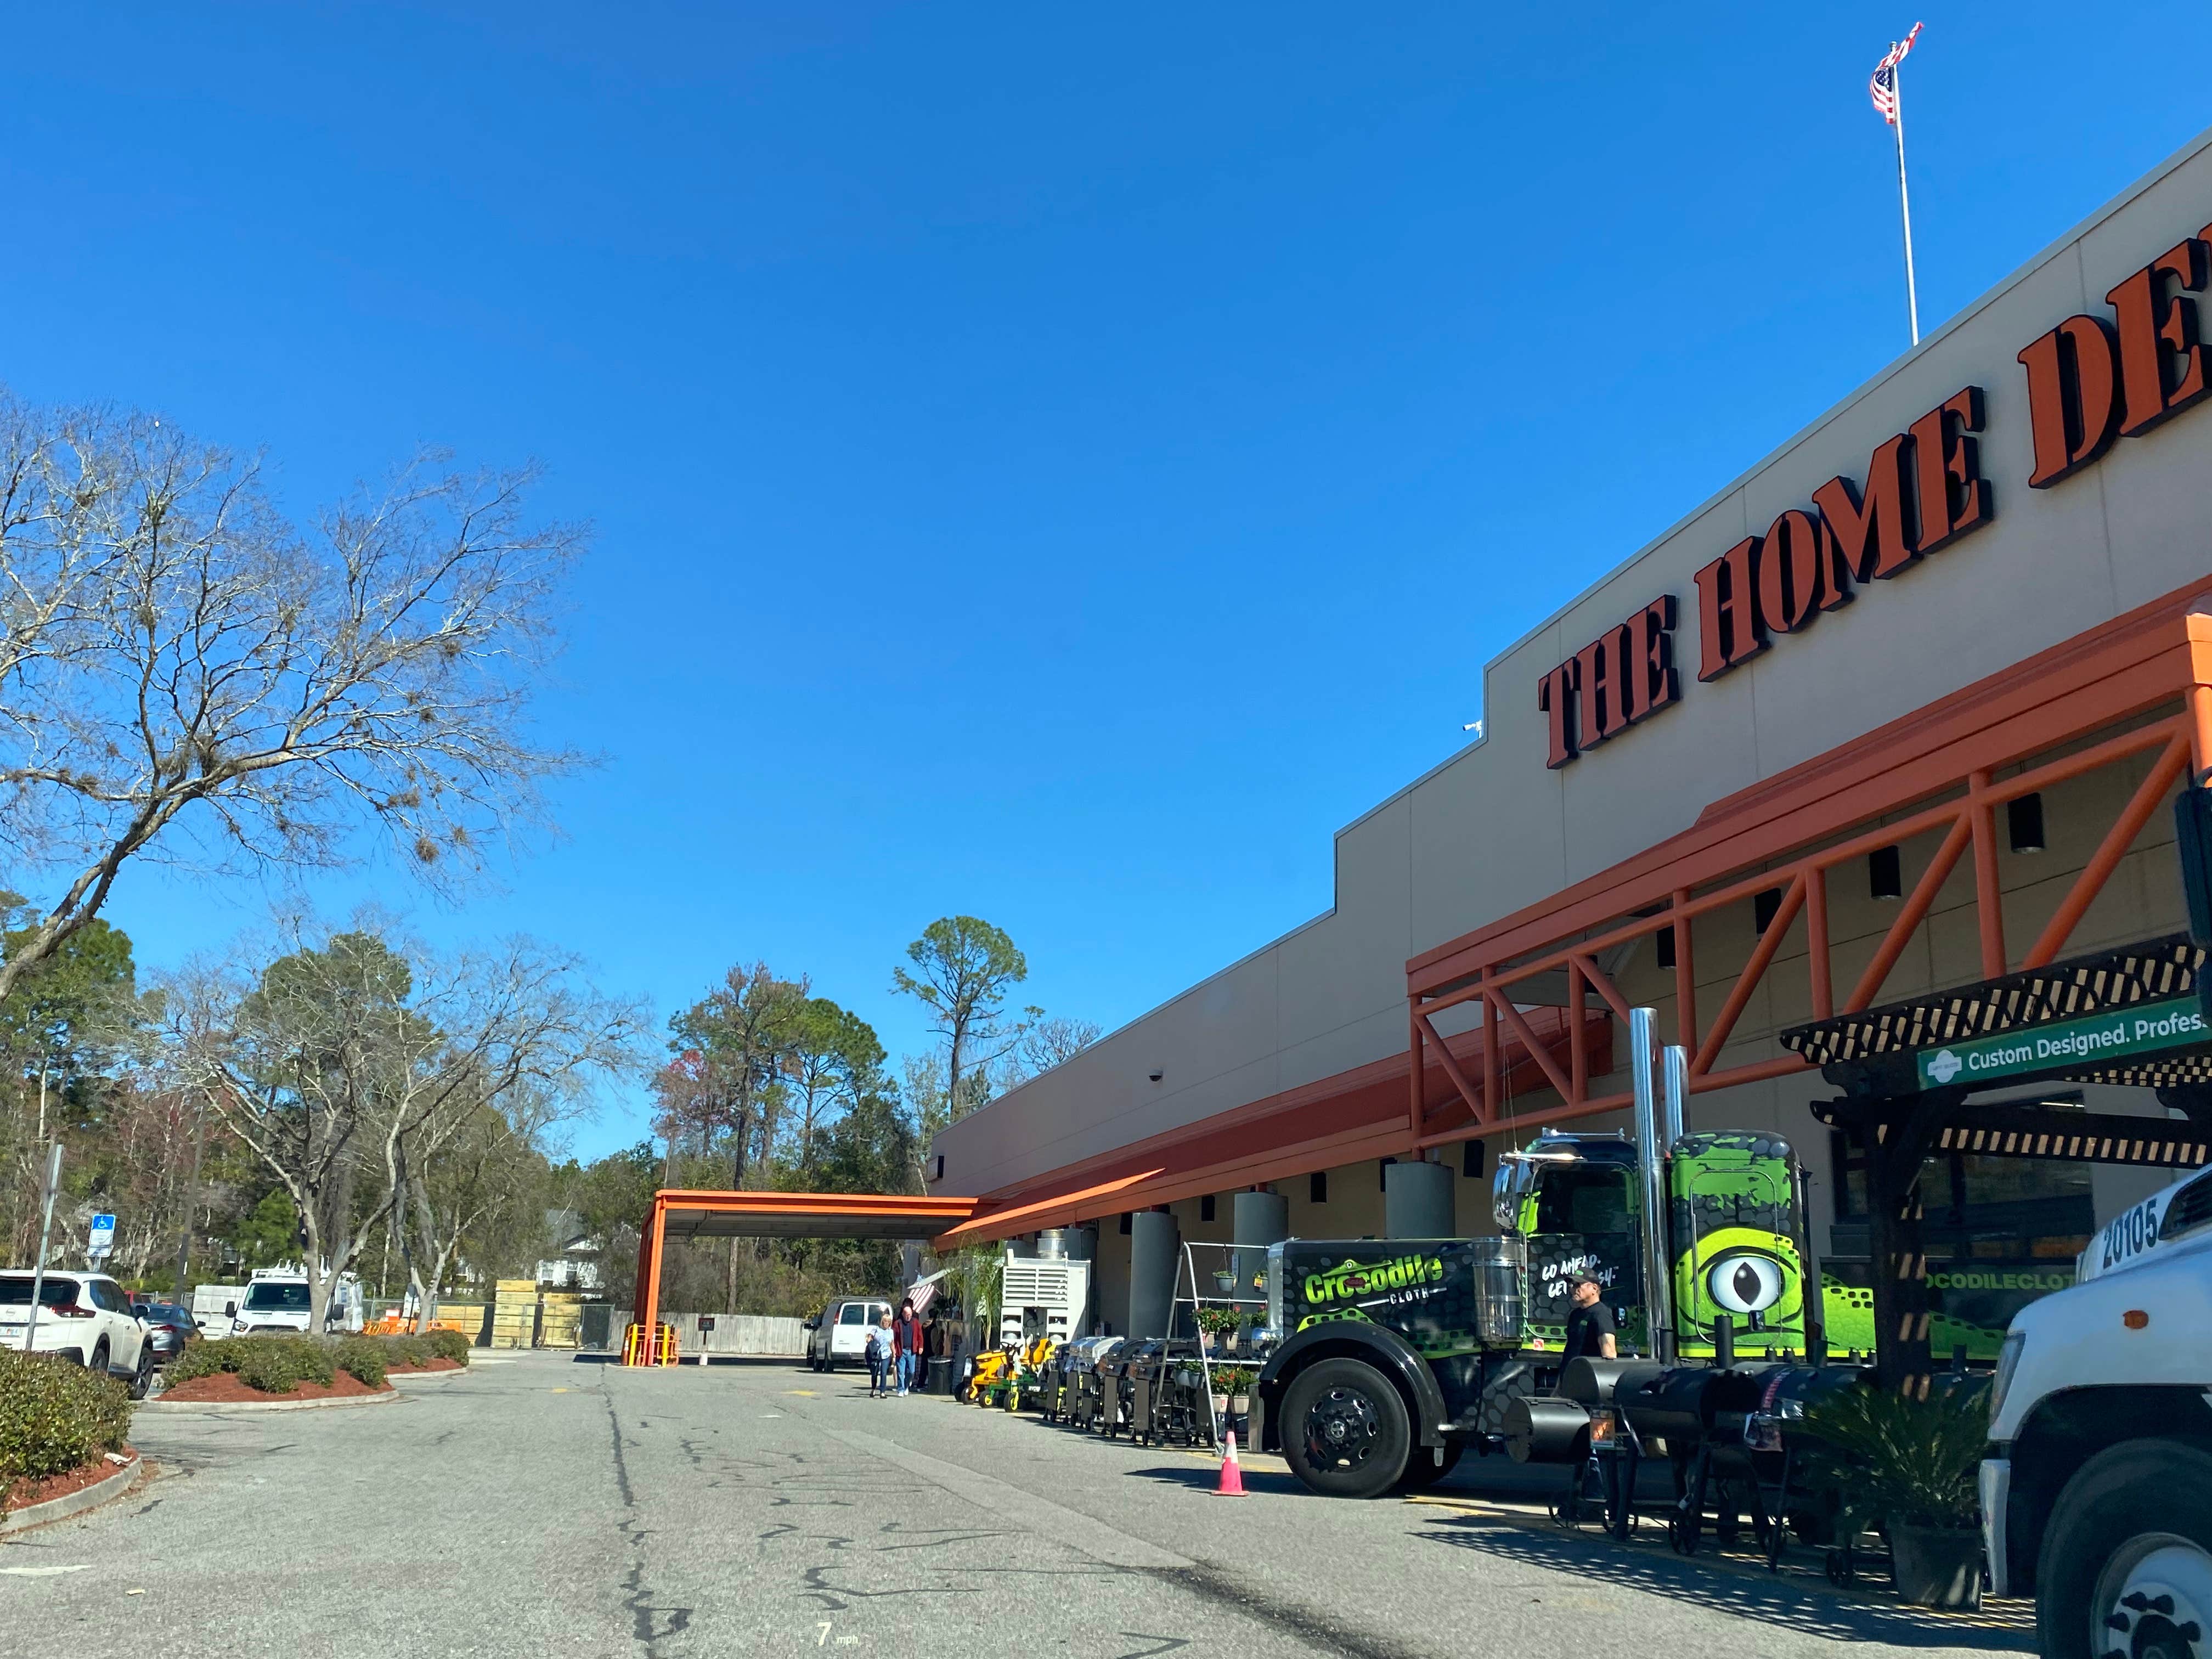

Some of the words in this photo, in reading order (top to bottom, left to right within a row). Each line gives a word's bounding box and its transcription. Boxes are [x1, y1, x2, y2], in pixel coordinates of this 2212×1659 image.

[1538, 594, 1680, 769] THE
[1694, 385, 1994, 683] HOME
[2017, 222, 2212, 489] DE
[1968, 1047, 2032, 1070] Custom
[2037, 1023, 2130, 1059] Designed.
[2135, 1012, 2208, 1040] Profes
[2103, 1198, 2157, 1269] 20105
[1305, 1254, 1443, 1304] Crocodile
[1542, 1264, 1558, 1281] GO
[1548, 1280, 1567, 1298] GET
[1390, 1288, 1430, 1305] CLOTH
[817, 1622, 832, 1646] 7
[837, 1635, 859, 1645] mph
